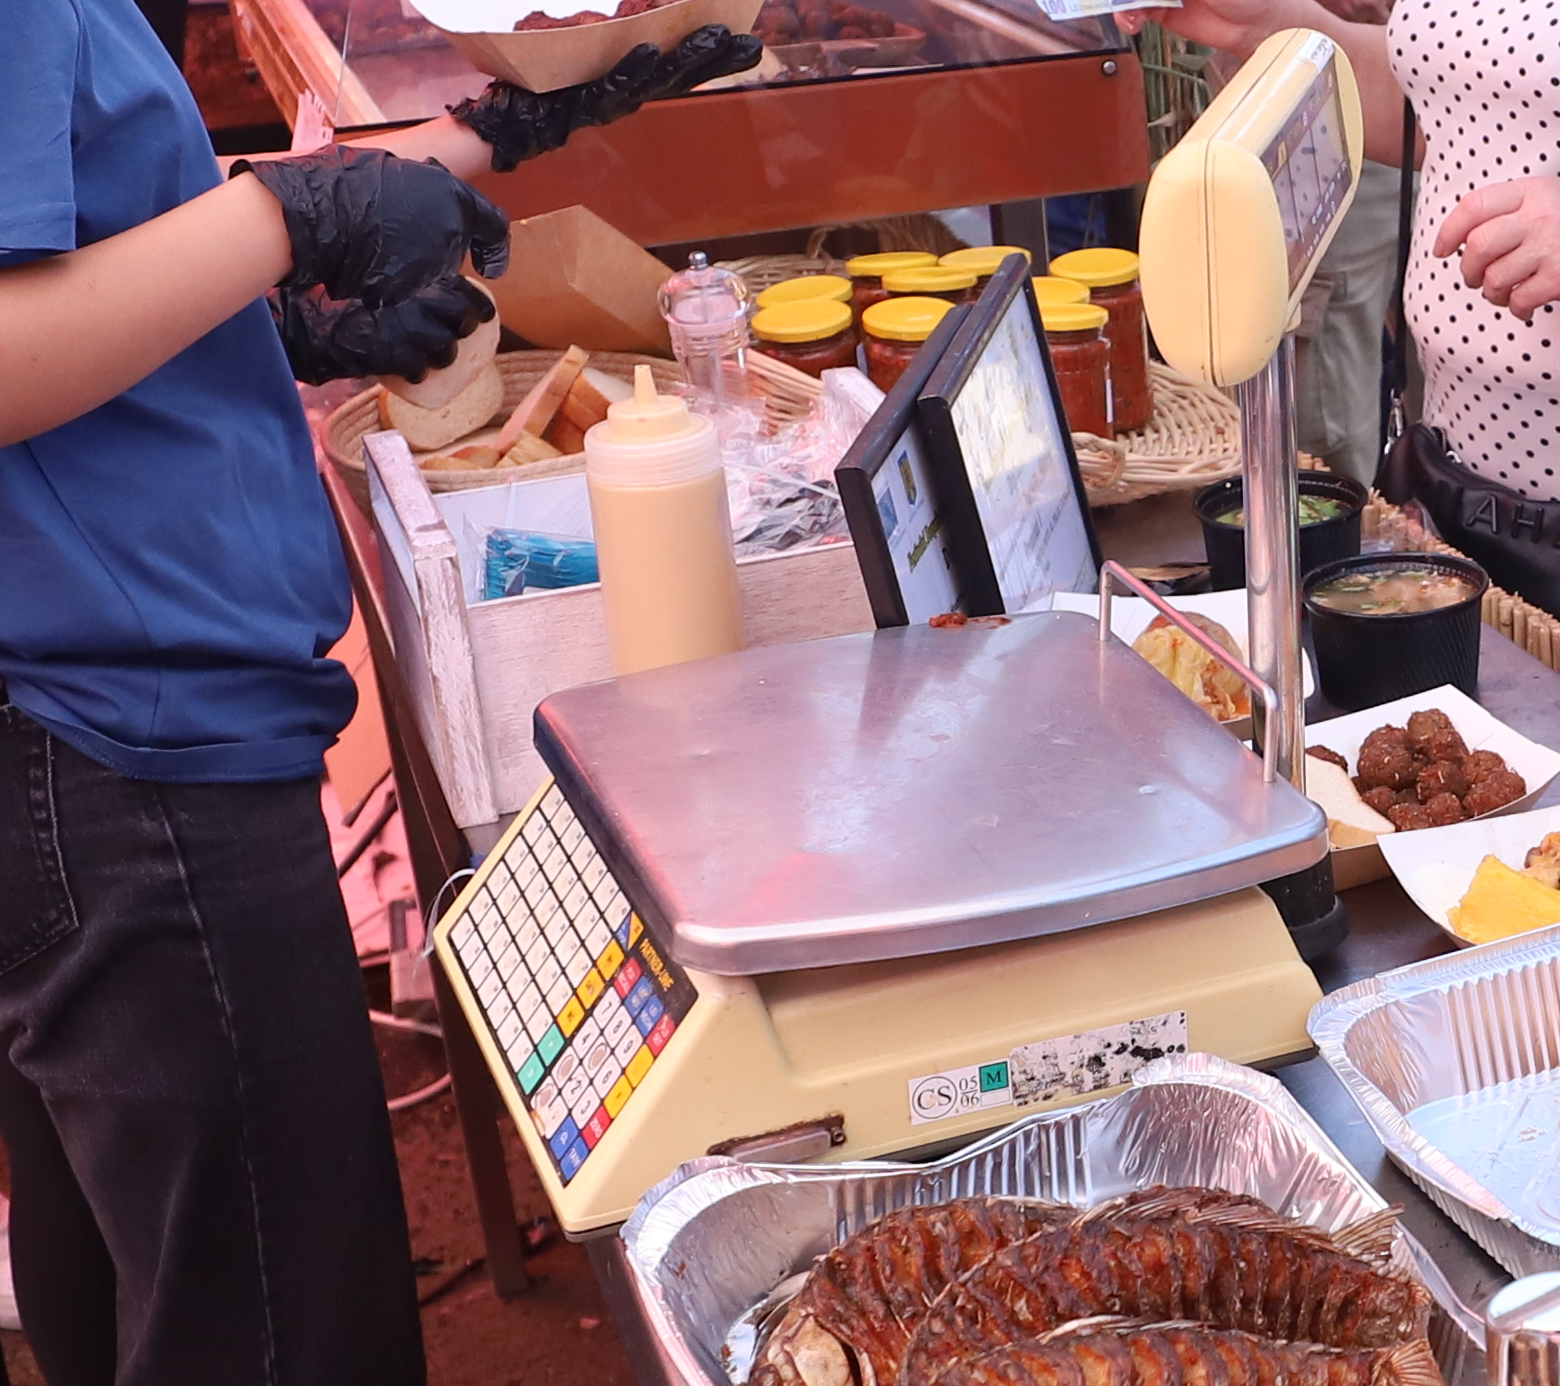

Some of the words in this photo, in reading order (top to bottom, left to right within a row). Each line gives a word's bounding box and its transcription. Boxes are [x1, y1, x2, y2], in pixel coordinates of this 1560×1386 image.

[958, 1075, 979, 1092] 05
[984, 1068, 1004, 1084] M
[915, 1084, 955, 1111] CS
